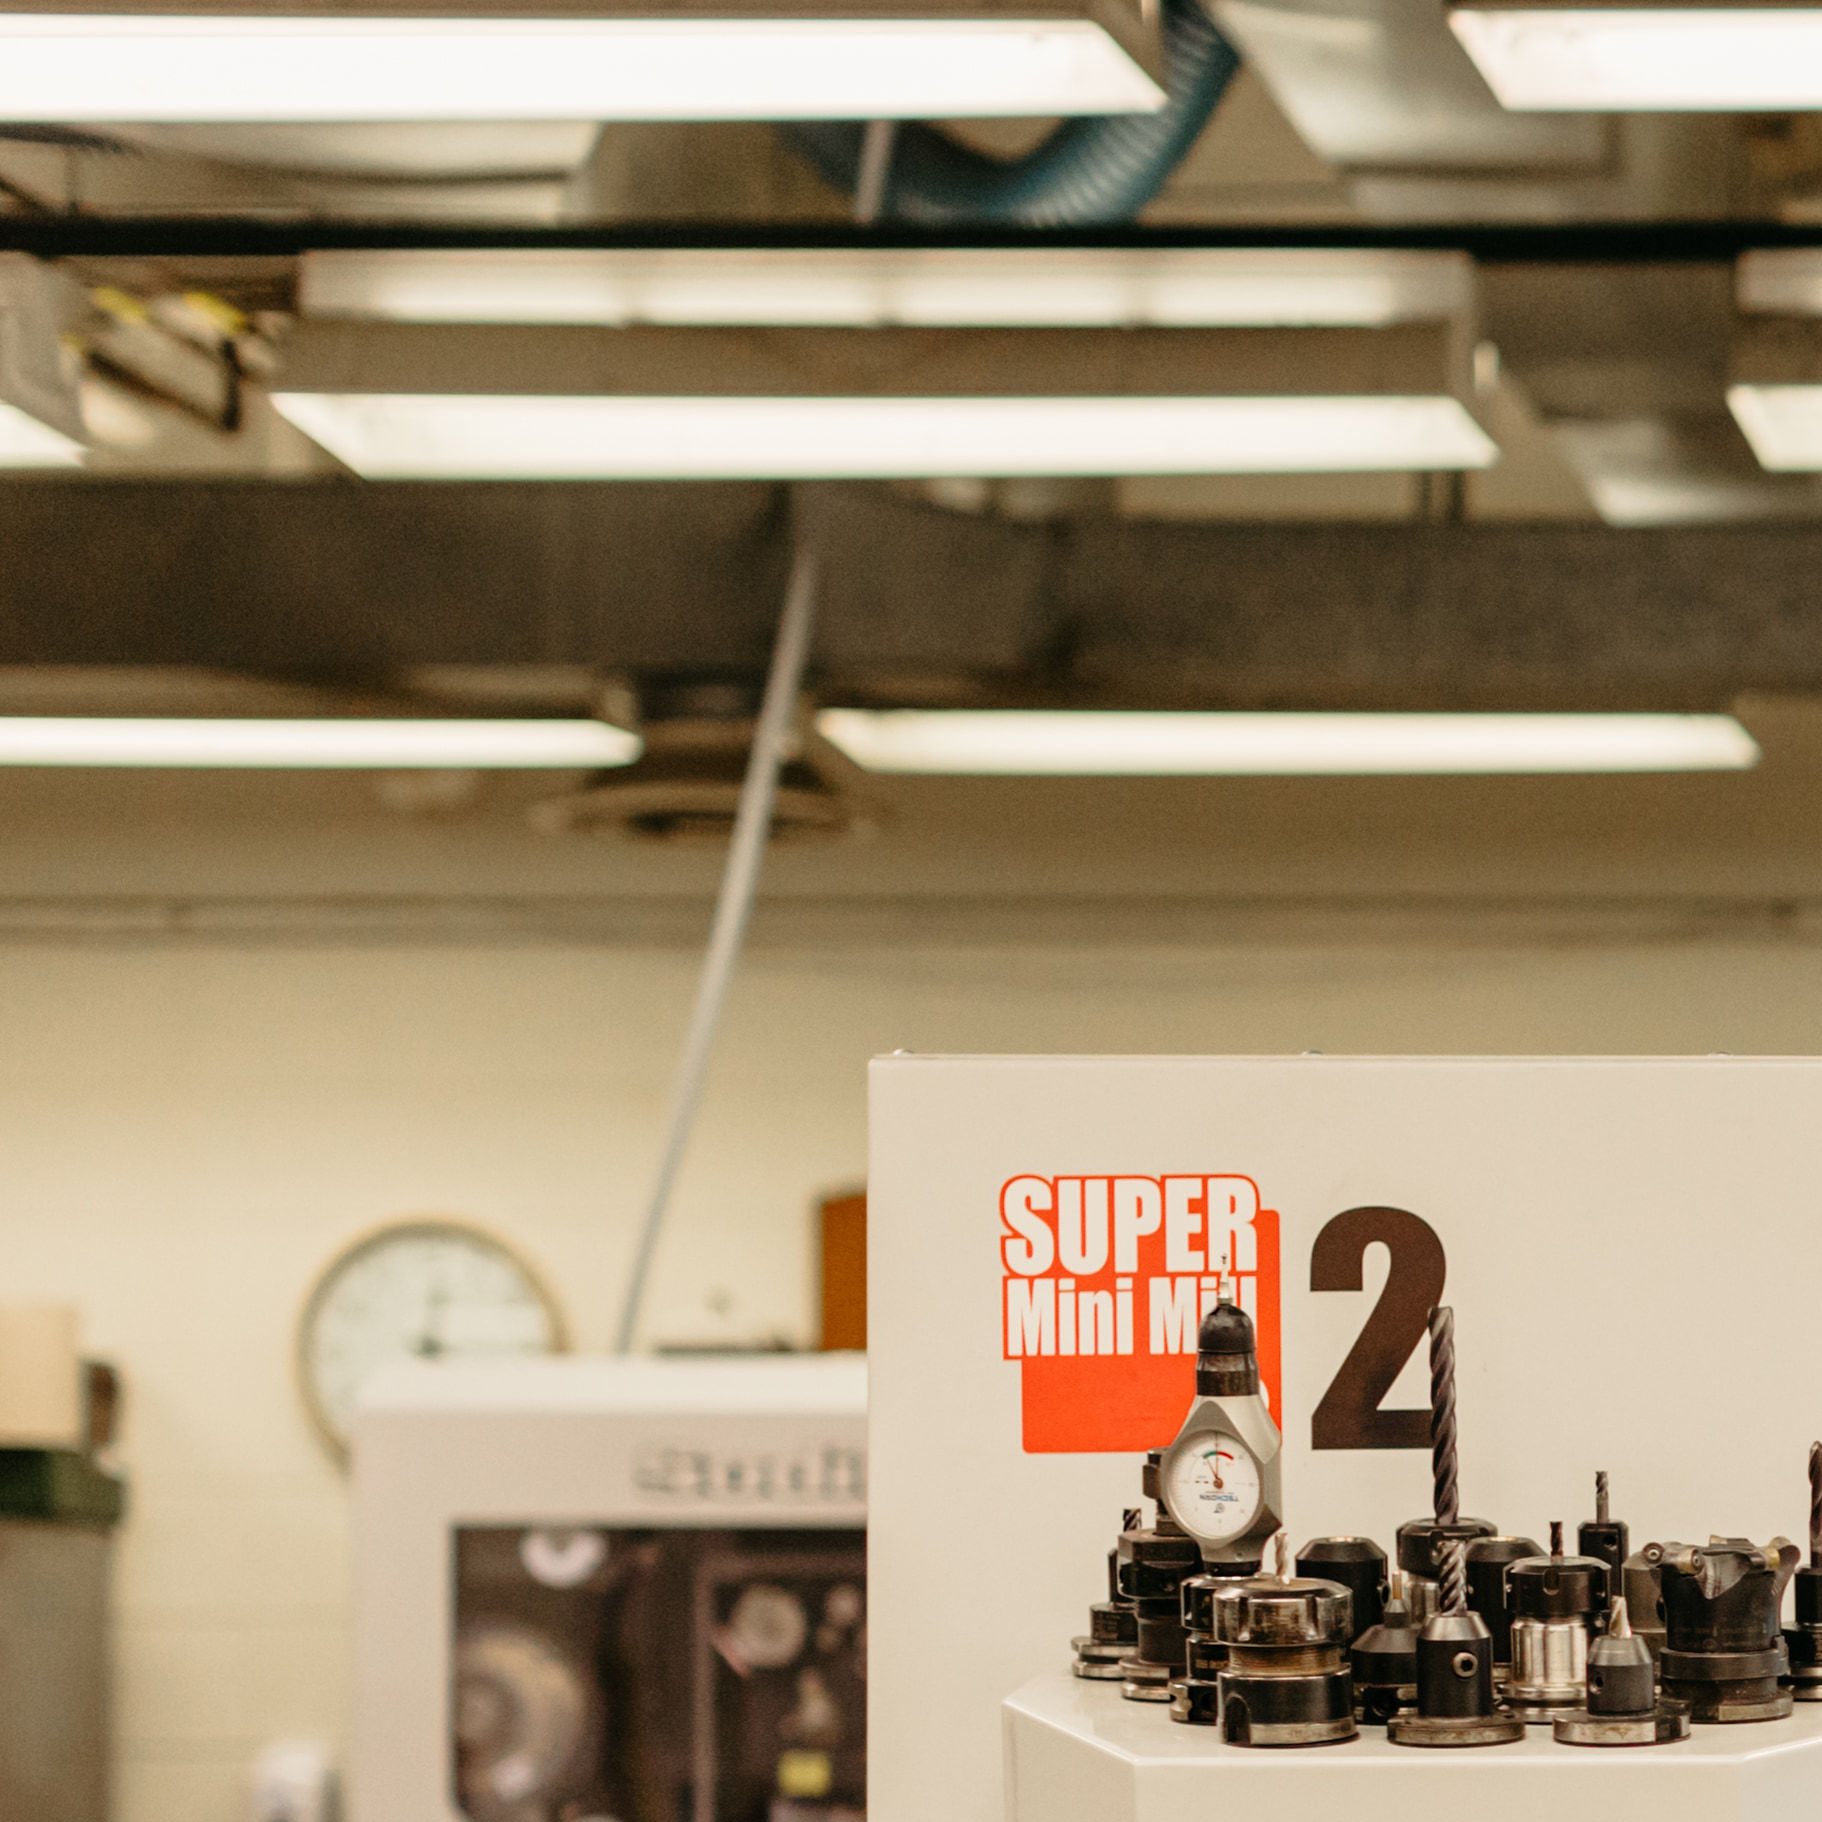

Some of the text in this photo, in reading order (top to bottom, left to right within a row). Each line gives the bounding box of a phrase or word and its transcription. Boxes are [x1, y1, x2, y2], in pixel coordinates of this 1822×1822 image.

[1000, 1176, 1260, 1277] SUPER
[1006, 1277, 1134, 1356] Mini
[1310, 1206, 1447, 1450] 2
